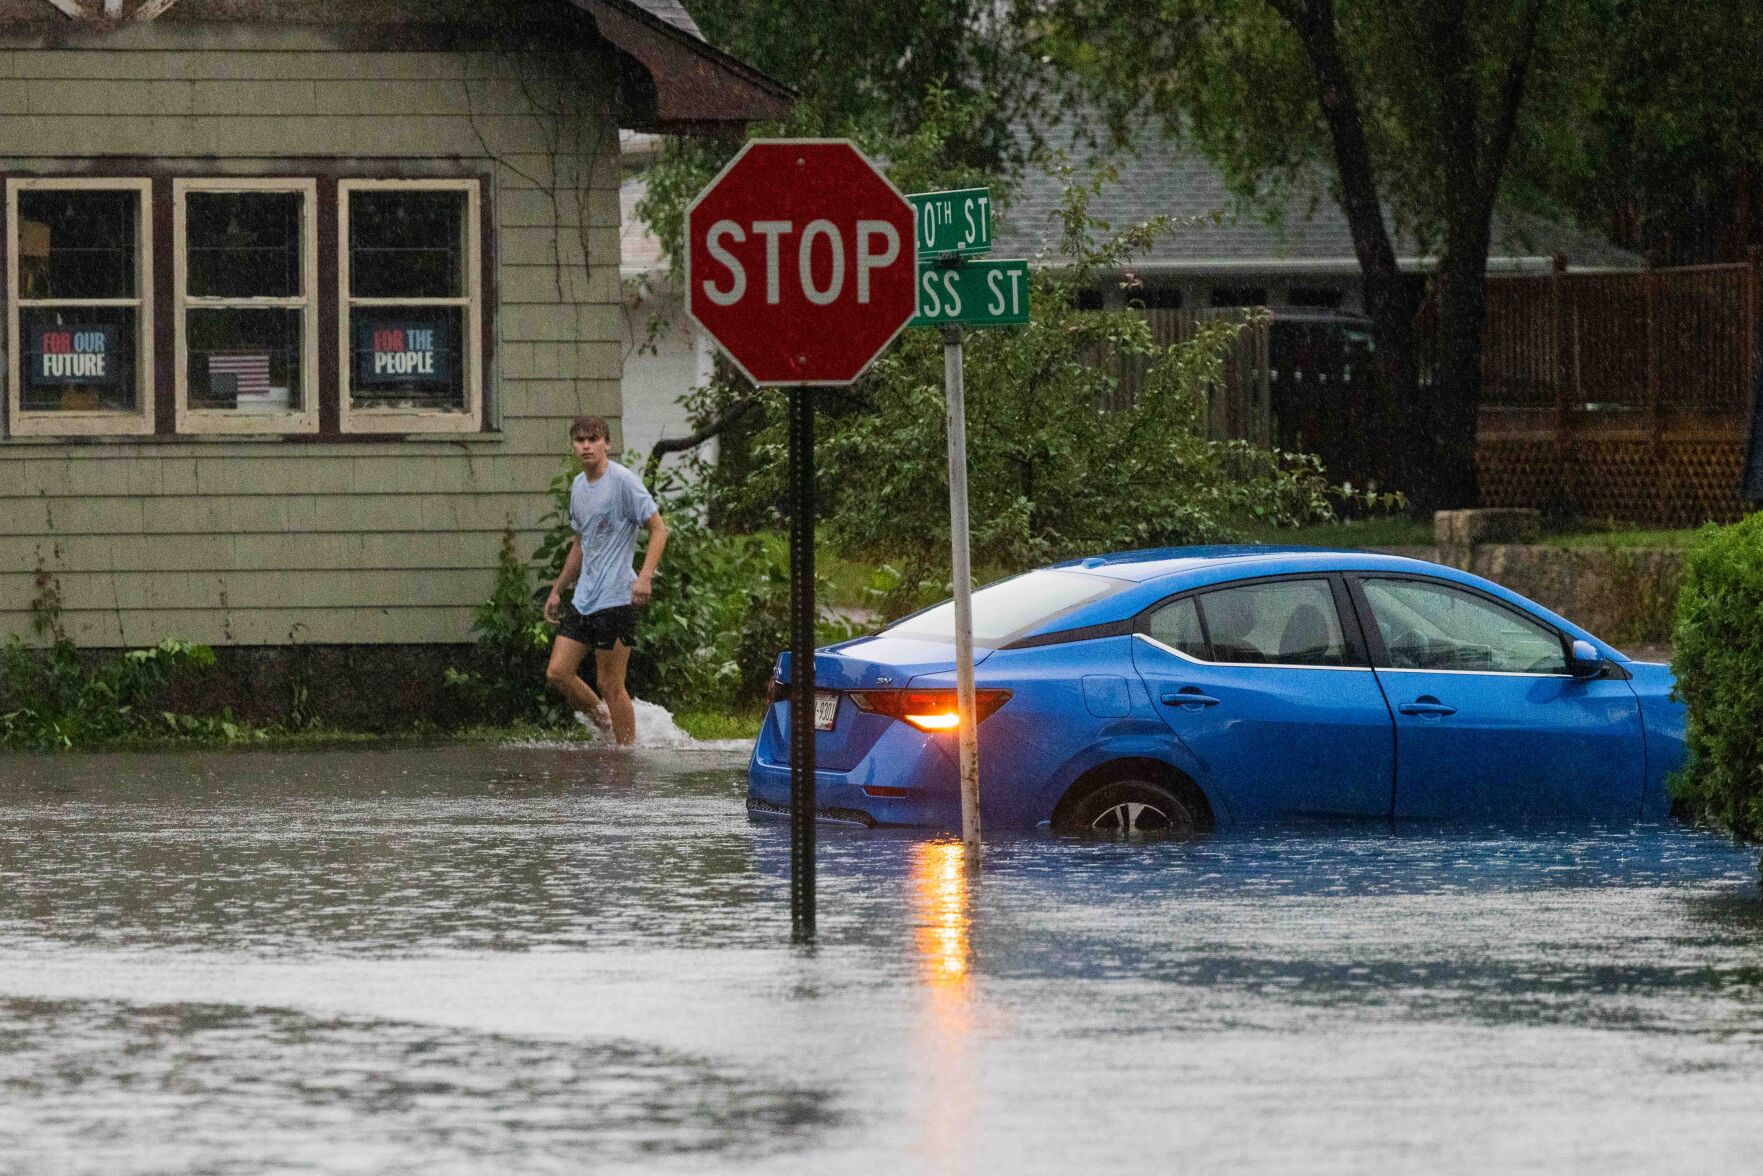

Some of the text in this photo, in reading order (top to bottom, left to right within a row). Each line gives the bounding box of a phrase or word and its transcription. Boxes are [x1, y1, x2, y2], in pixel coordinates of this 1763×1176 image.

[911, 197, 988, 248] 0TH ST
[703, 219, 900, 306] STOP
[917, 269, 1023, 318] SS ST
[43, 331, 106, 353] FOR OUR
[374, 329, 434, 352] FOR THE
[43, 353, 106, 377] FUTURE
[375, 351, 434, 374] PEOPLE
